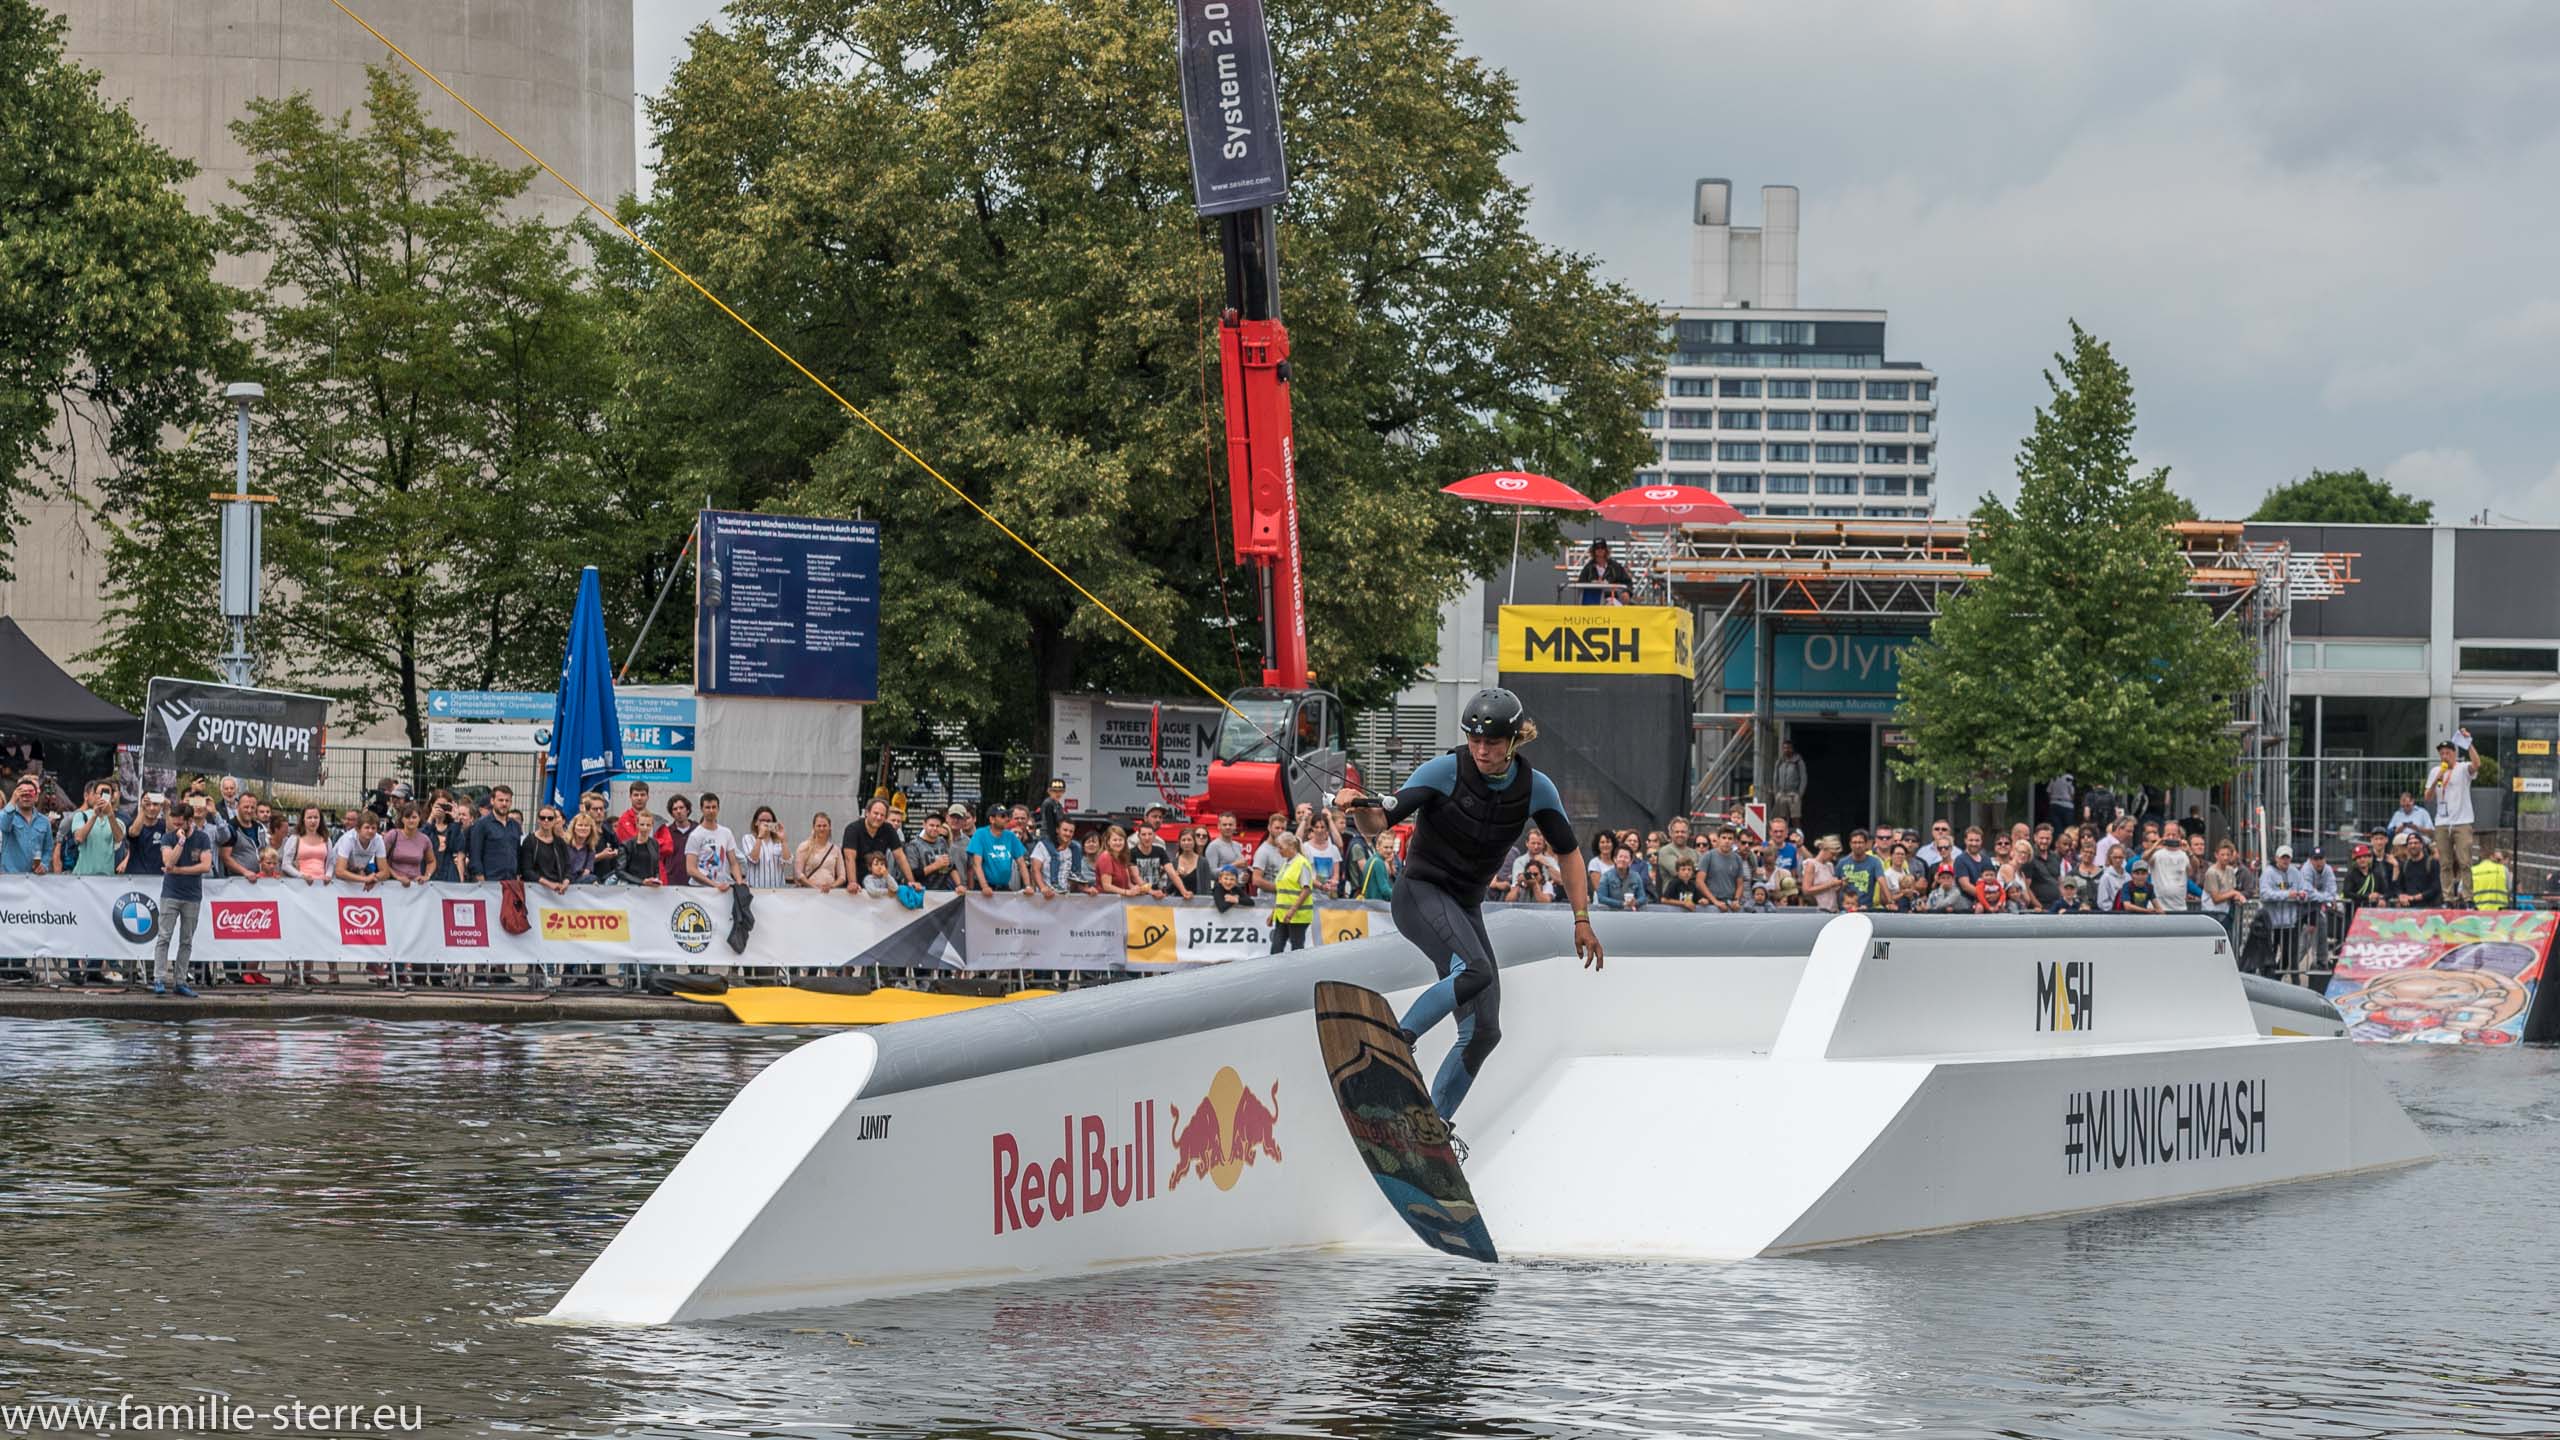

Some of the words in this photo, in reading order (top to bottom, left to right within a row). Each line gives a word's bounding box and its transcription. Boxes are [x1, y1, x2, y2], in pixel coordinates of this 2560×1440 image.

[1204, 3, 1233, 46] 2.0
[1217, 53, 1251, 160] System
[1563, 616, 1611, 625] MUNICH
[1525, 627, 1640, 663] MASH
[1106, 720, 1147, 732] STREET
[644, 758, 667, 769] CITY
[1172, 773, 1190, 783] AIR
[0, 909, 78, 926] Vereinsbank
[217, 908, 273, 930] Coca-Cola
[568, 915, 619, 930] LOTTO
[450, 929, 481, 937] Leonardo
[995, 927, 1040, 936] Breitsamer
[1069, 929, 1115, 937] Breitsamer
[2036, 960, 2093, 1032] MASH
[2065, 1079, 2265, 1175] #MUNICHMASH
[993, 1115, 1074, 1235] Red
[1081, 1099, 1155, 1214] Bull
